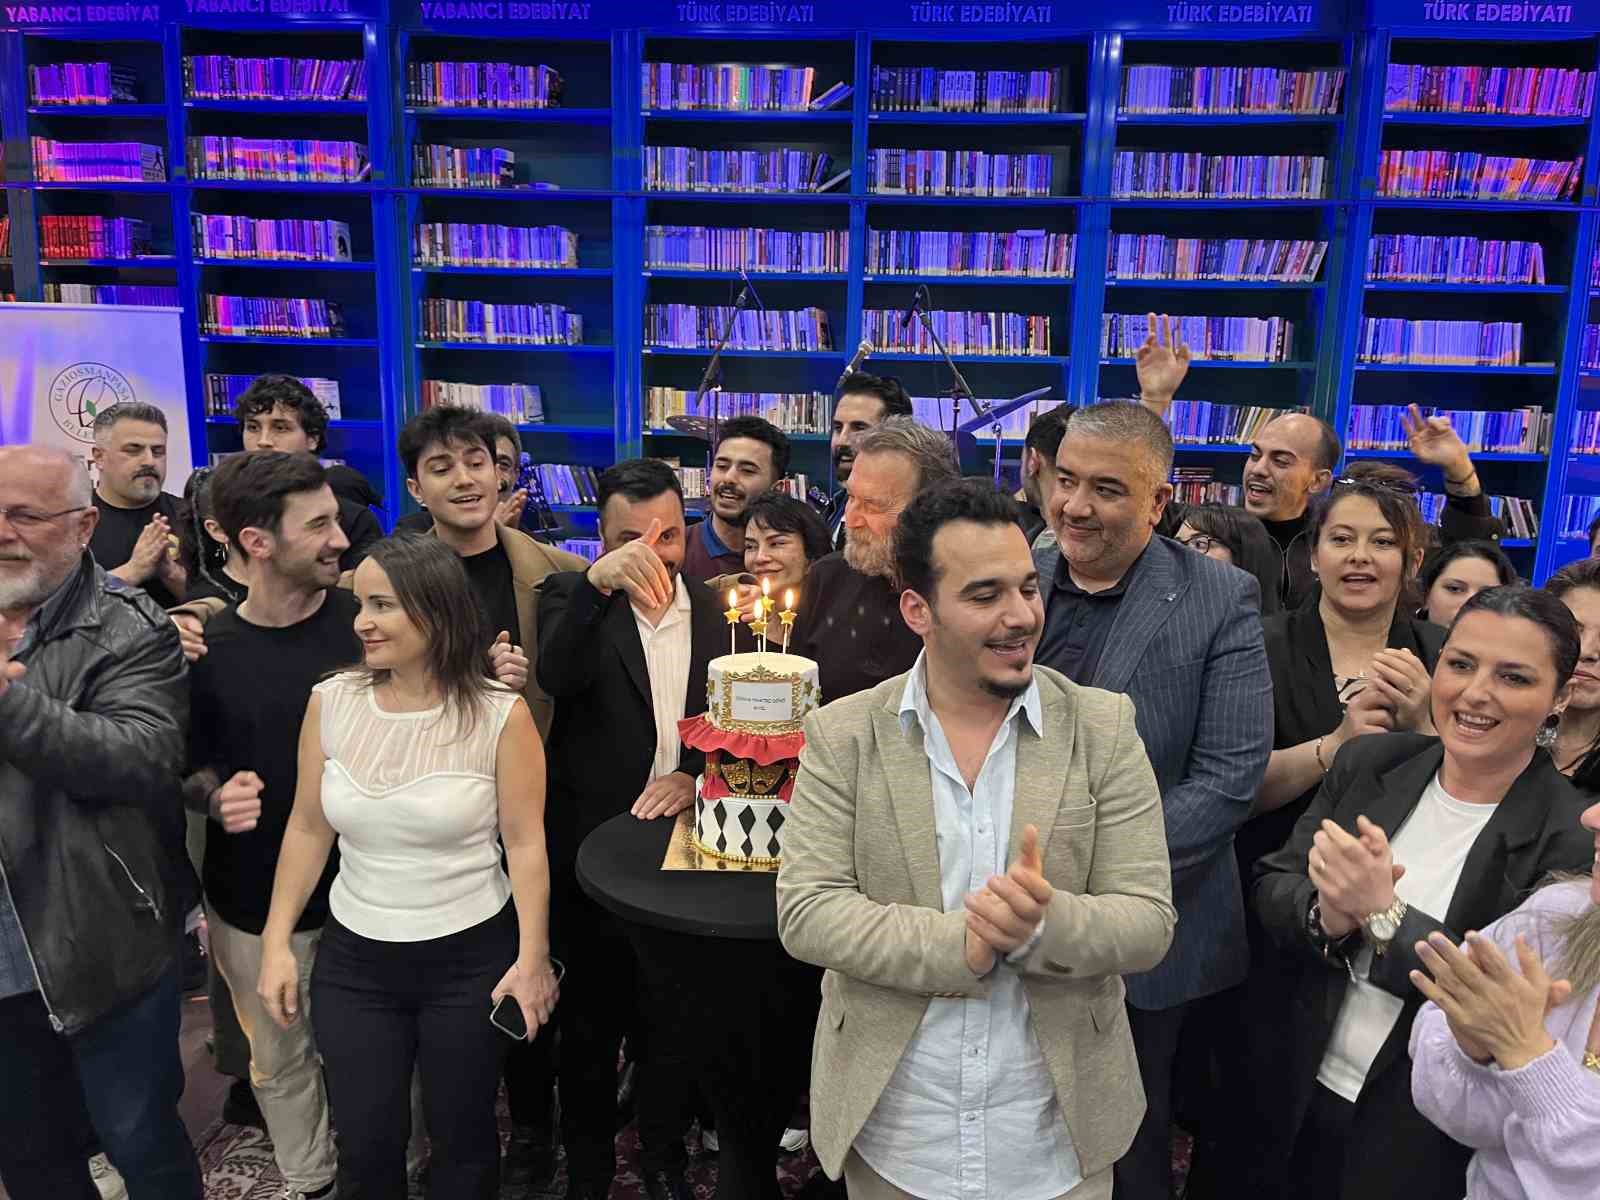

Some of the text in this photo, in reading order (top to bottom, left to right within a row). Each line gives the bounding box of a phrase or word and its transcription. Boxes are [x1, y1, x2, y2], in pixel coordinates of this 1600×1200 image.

[6, 2, 160, 22] YABANCI EDEBİYAT
[420, 0, 591, 20] YABANCI EDEBİYAT
[677, 1, 814, 22] TÜRK EDEBİYATI
[910, 2, 1051, 23] TÜRK EDEBİYATI
[1167, 1, 1312, 23] TÜRK EDEBİYATI
[1424, 0, 1572, 23] TÜRK EDEBİYATI
